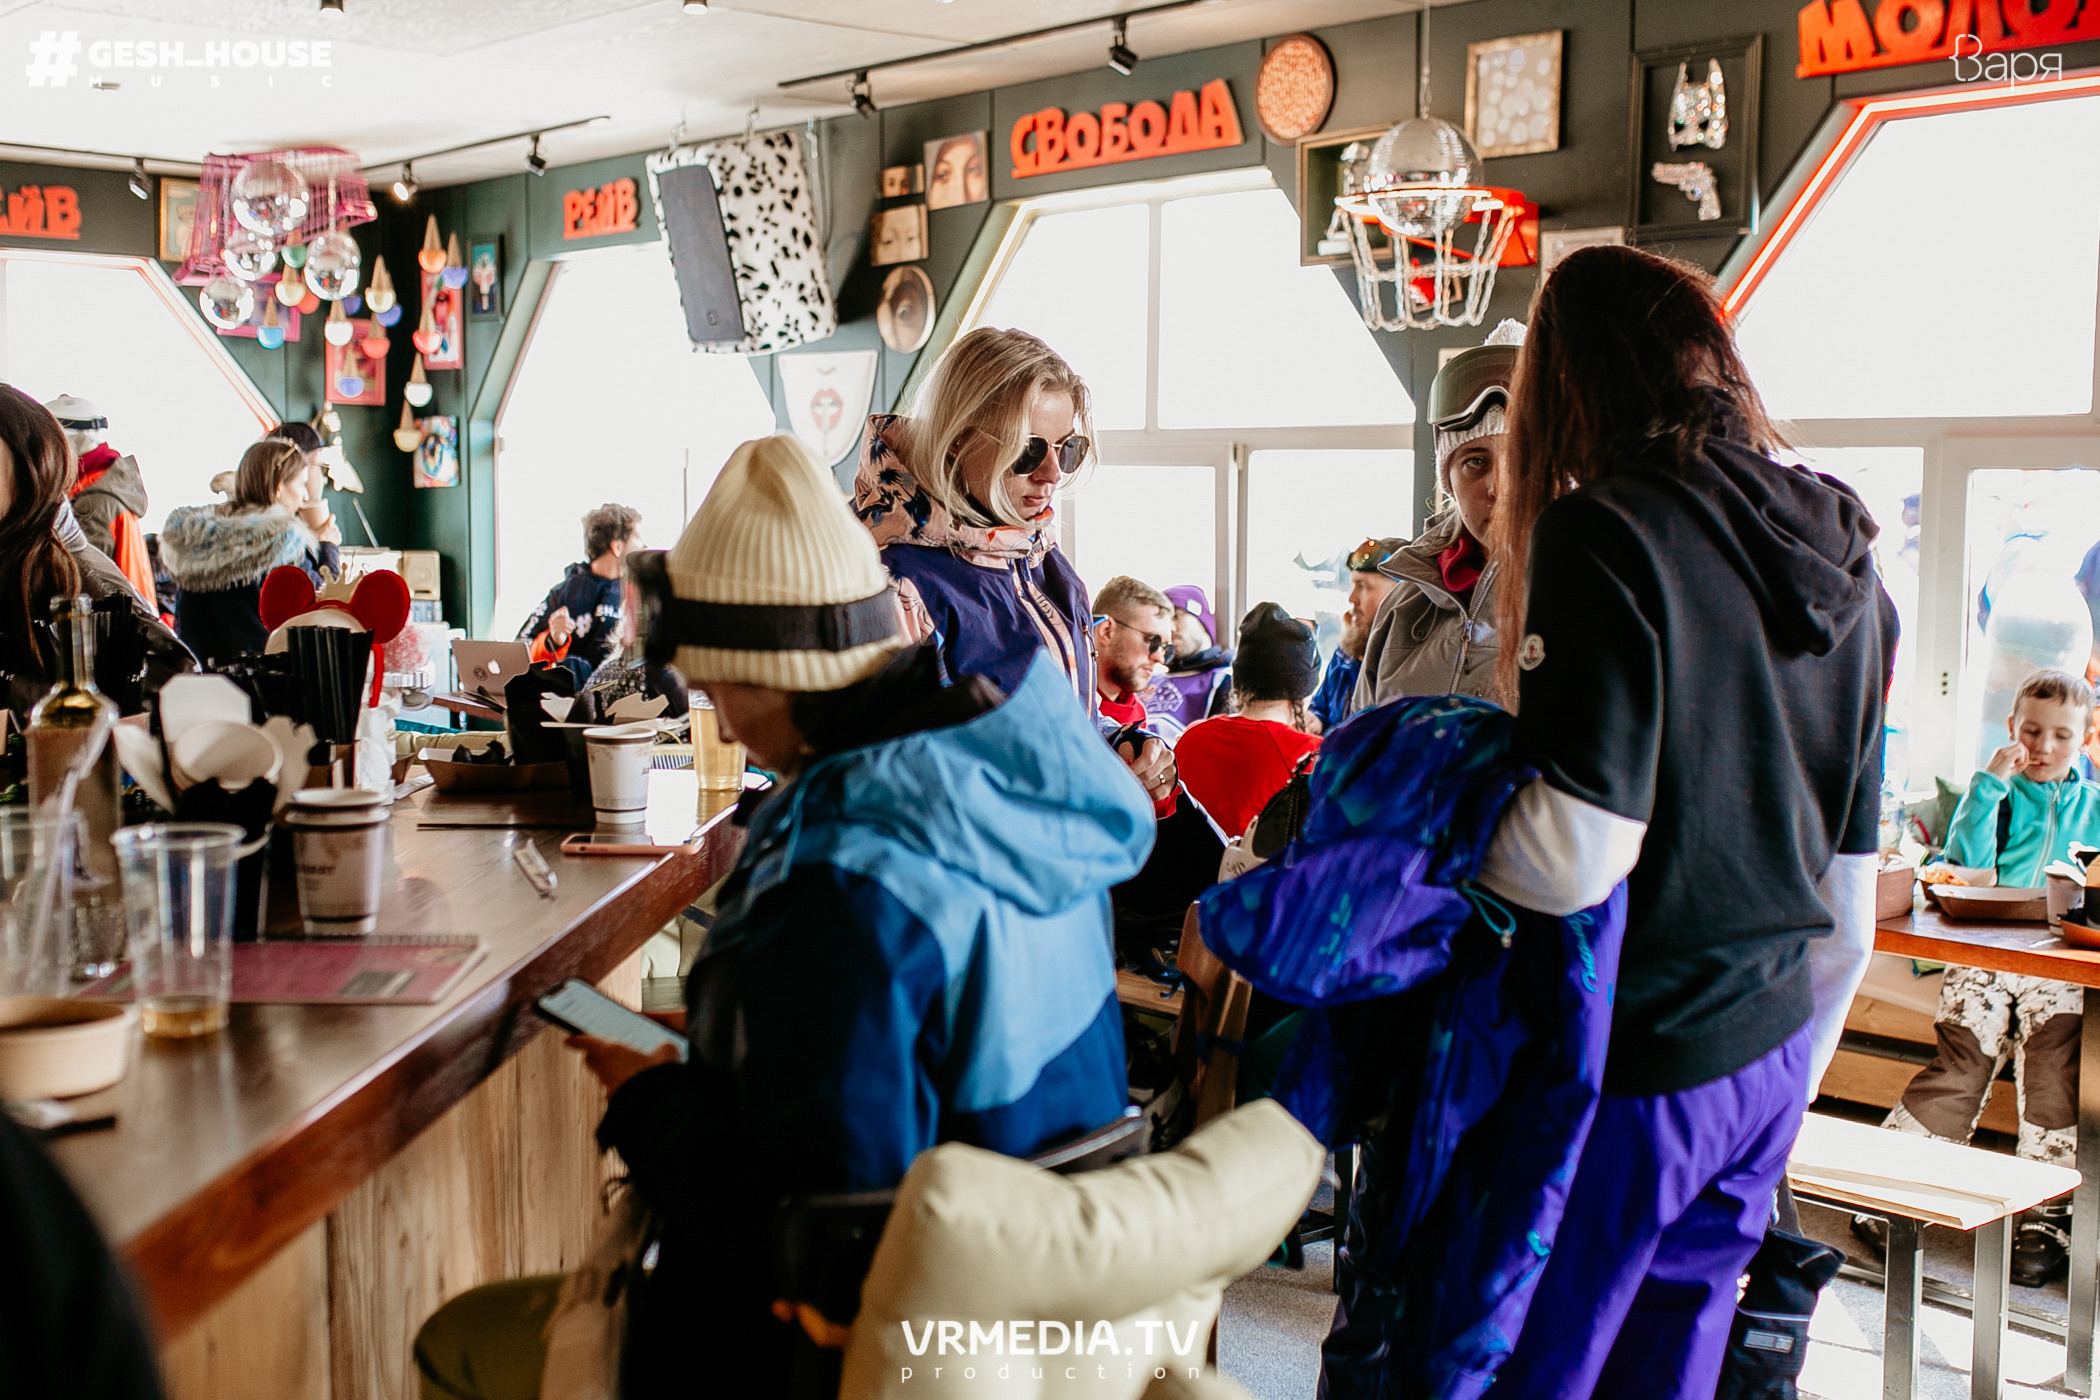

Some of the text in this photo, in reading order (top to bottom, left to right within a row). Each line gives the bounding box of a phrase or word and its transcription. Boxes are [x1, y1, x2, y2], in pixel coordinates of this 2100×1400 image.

[1796, 0, 2100, 79] МОЛО
[1010, 78, 1244, 178] СВОБОДА
[563, 177, 637, 240] РЕЙВ
